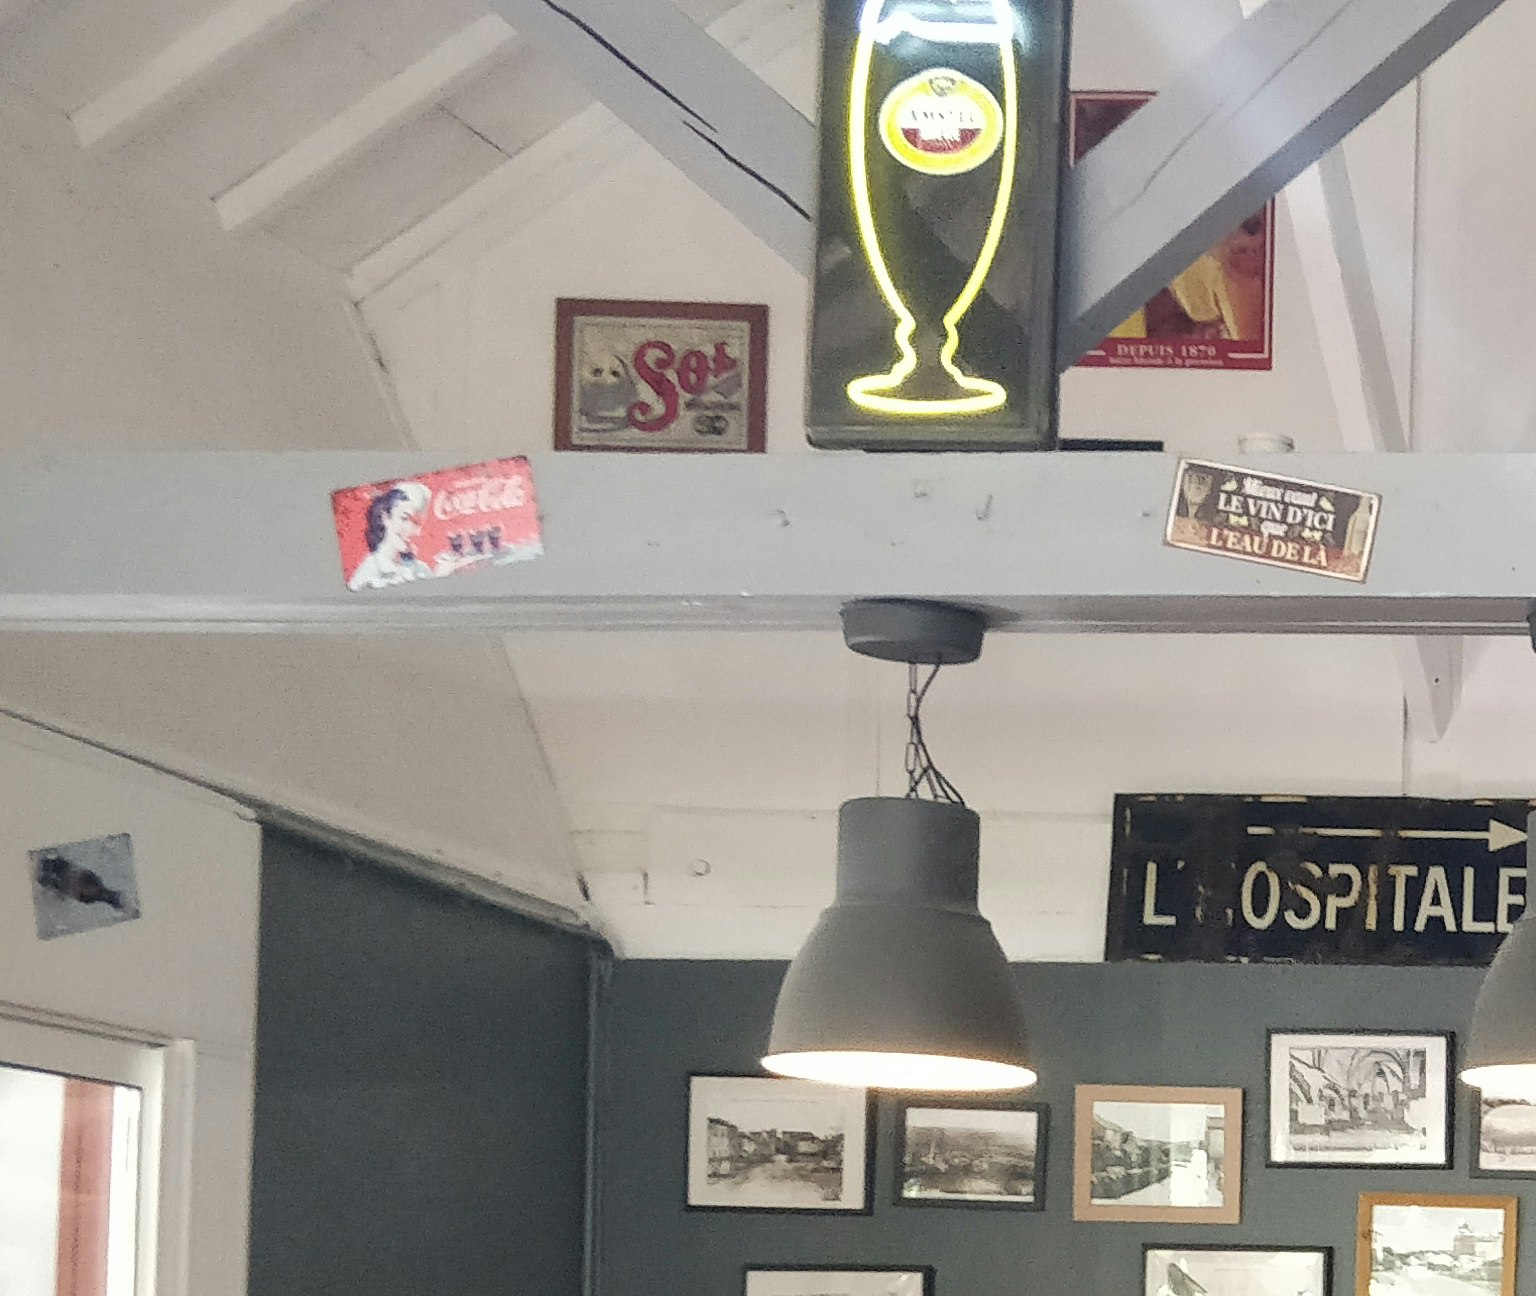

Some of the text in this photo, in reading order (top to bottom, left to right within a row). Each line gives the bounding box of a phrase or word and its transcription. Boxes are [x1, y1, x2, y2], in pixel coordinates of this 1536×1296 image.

[1217, 492, 1336, 532] LE VIN D'ICI
[1210, 527, 1269, 555] L'EAU
[1270, 539, 1300, 561] DE
